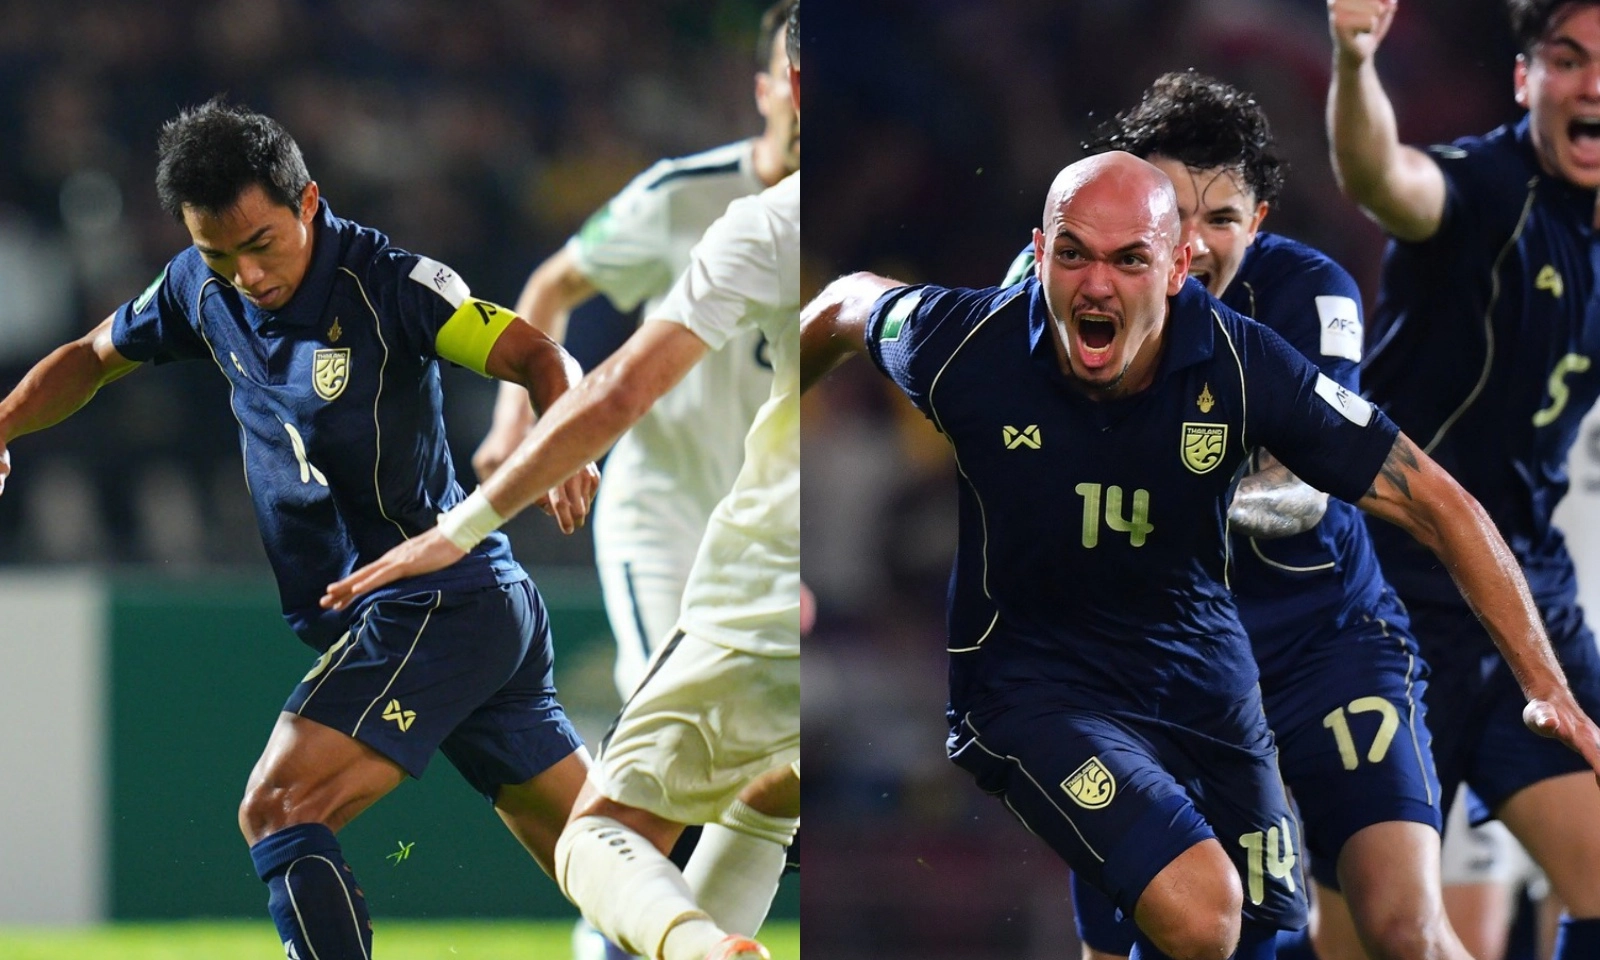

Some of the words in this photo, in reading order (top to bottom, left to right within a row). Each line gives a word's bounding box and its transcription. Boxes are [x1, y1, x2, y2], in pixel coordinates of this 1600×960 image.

[1327, 317, 1356, 335] AFC
[1532, 352, 1591, 428] 5
[1187, 427, 1223, 435] THAILAND
[1074, 482, 1154, 549] 14
[1323, 696, 1400, 771] 17
[1238, 816, 1297, 905] 14
